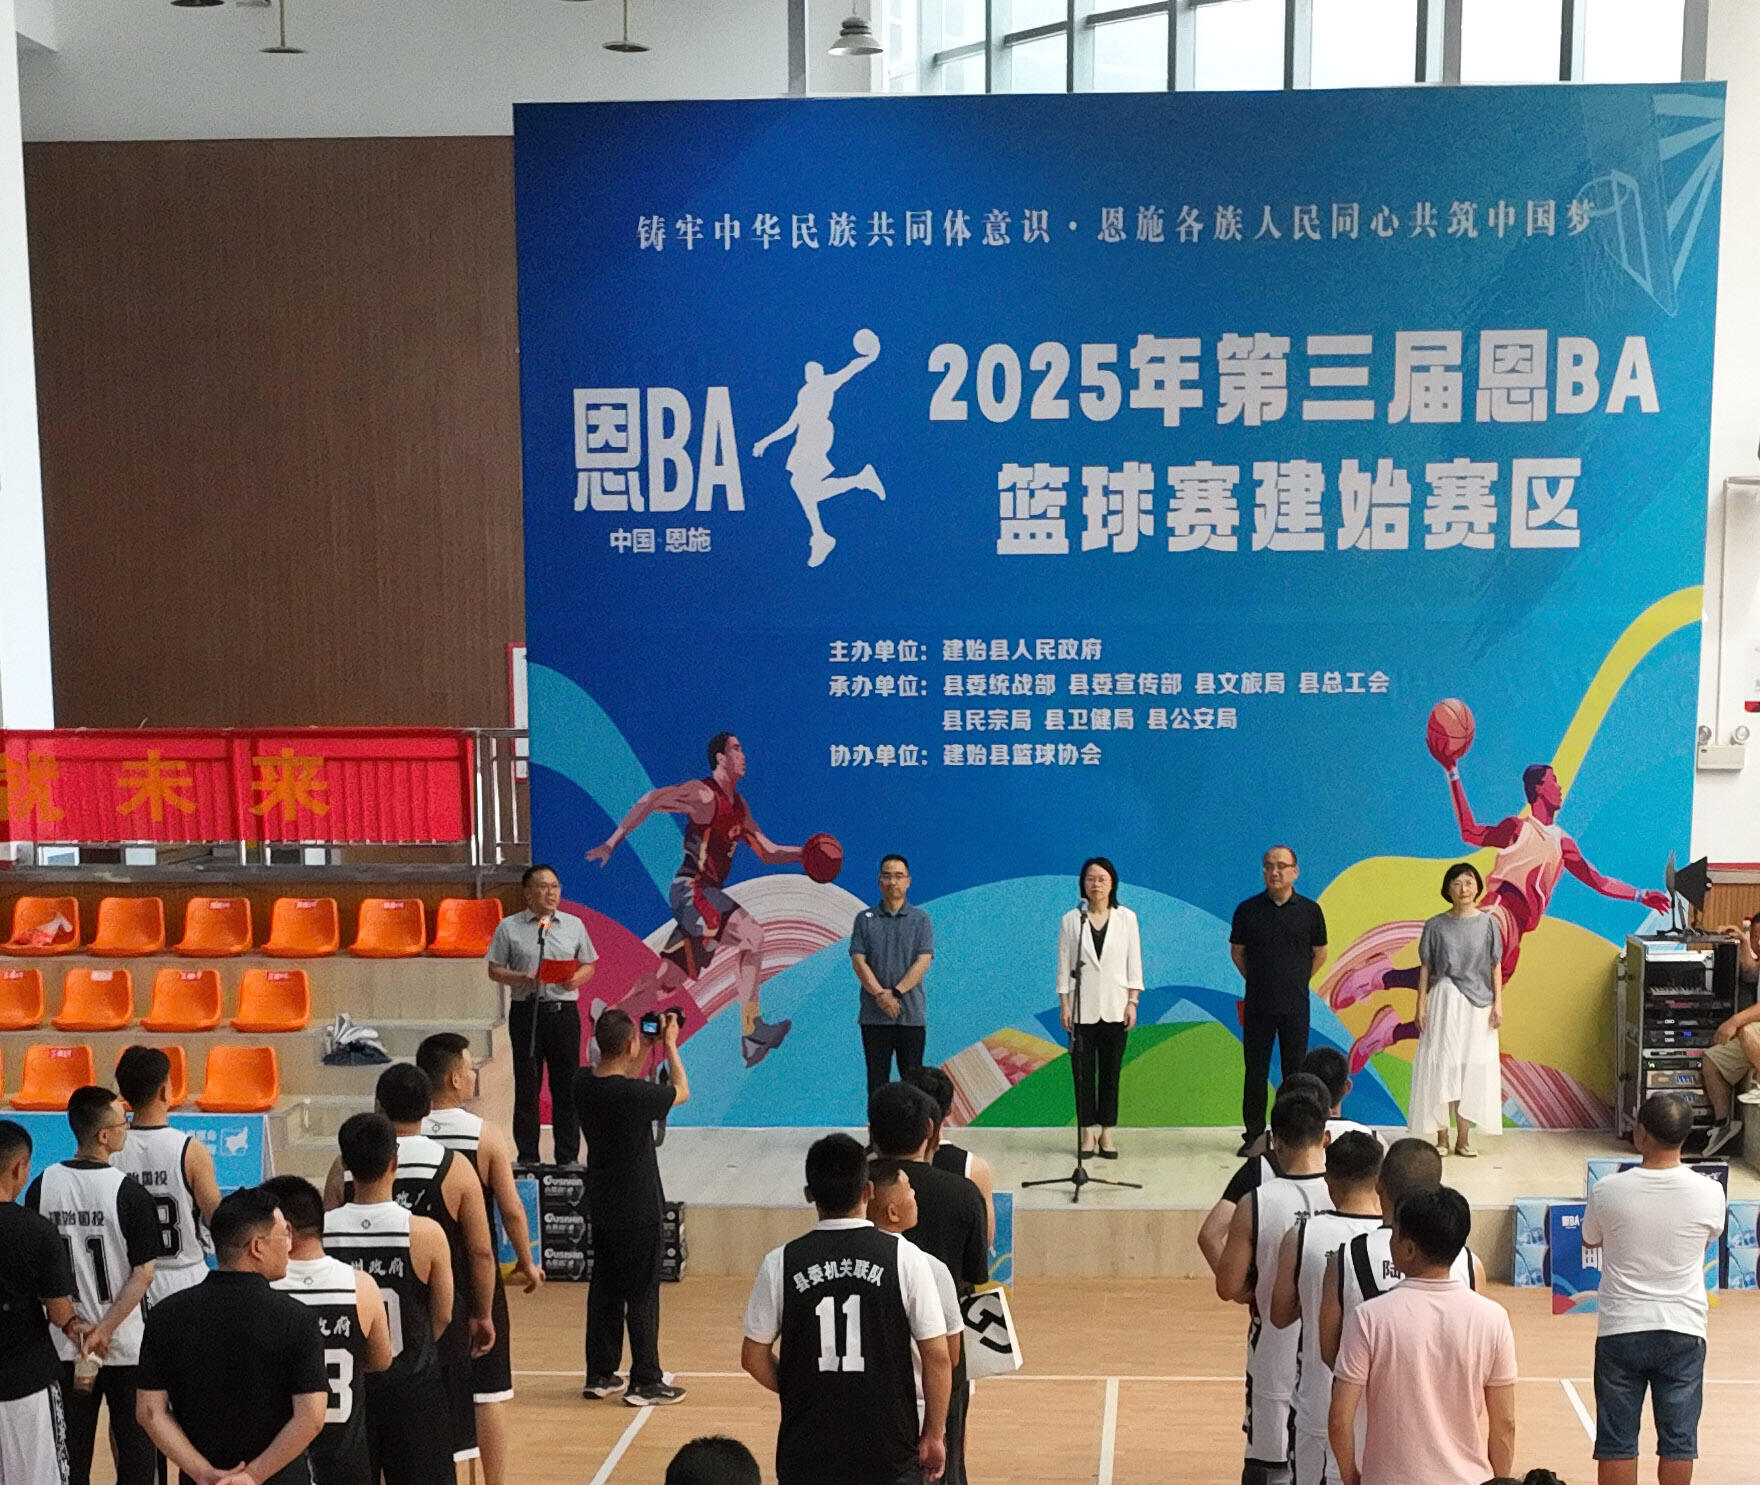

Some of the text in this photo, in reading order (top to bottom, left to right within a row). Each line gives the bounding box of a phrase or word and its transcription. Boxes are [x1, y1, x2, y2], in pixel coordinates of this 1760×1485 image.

[927, 329, 1661, 427] 2025年第三届恩BA
[572, 385, 745, 514] 恩BA
[996, 457, 1584, 556] 篮球赛建始赛区
[942, 707, 1238, 732] 县民宗局 县卫健局 县公安局
[1068, 672, 1183, 696] 县委宣传部
[1194, 671, 1286, 695] 县文旅局
[1298, 670, 1391, 695] 县总工会
[792, 1258, 886, 1294] 县委机关联队
[815, 1294, 866, 1372] 11
